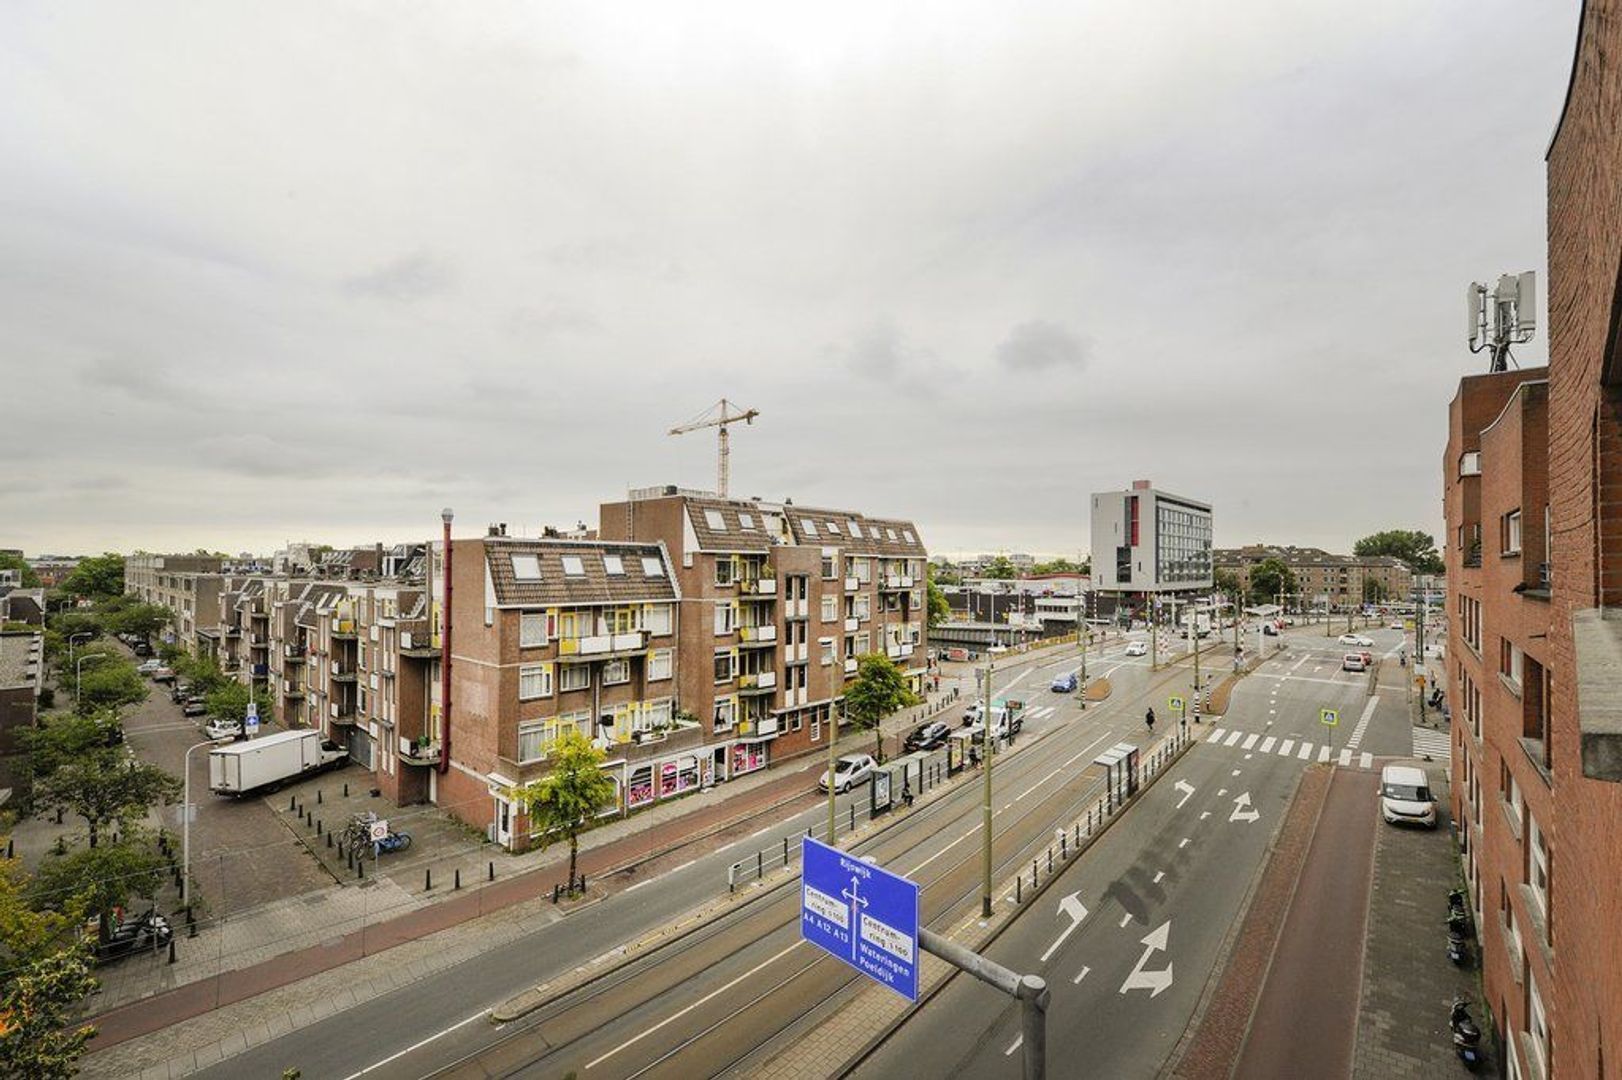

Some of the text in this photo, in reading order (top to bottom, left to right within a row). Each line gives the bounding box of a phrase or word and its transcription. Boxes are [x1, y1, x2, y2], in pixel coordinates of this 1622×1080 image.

[804, 912, 849, 943] A4 A12 A13
[869, 932, 886, 948] ring
[860, 943, 910, 977] Wateringen
[860, 956, 895, 984] Poeldijk
